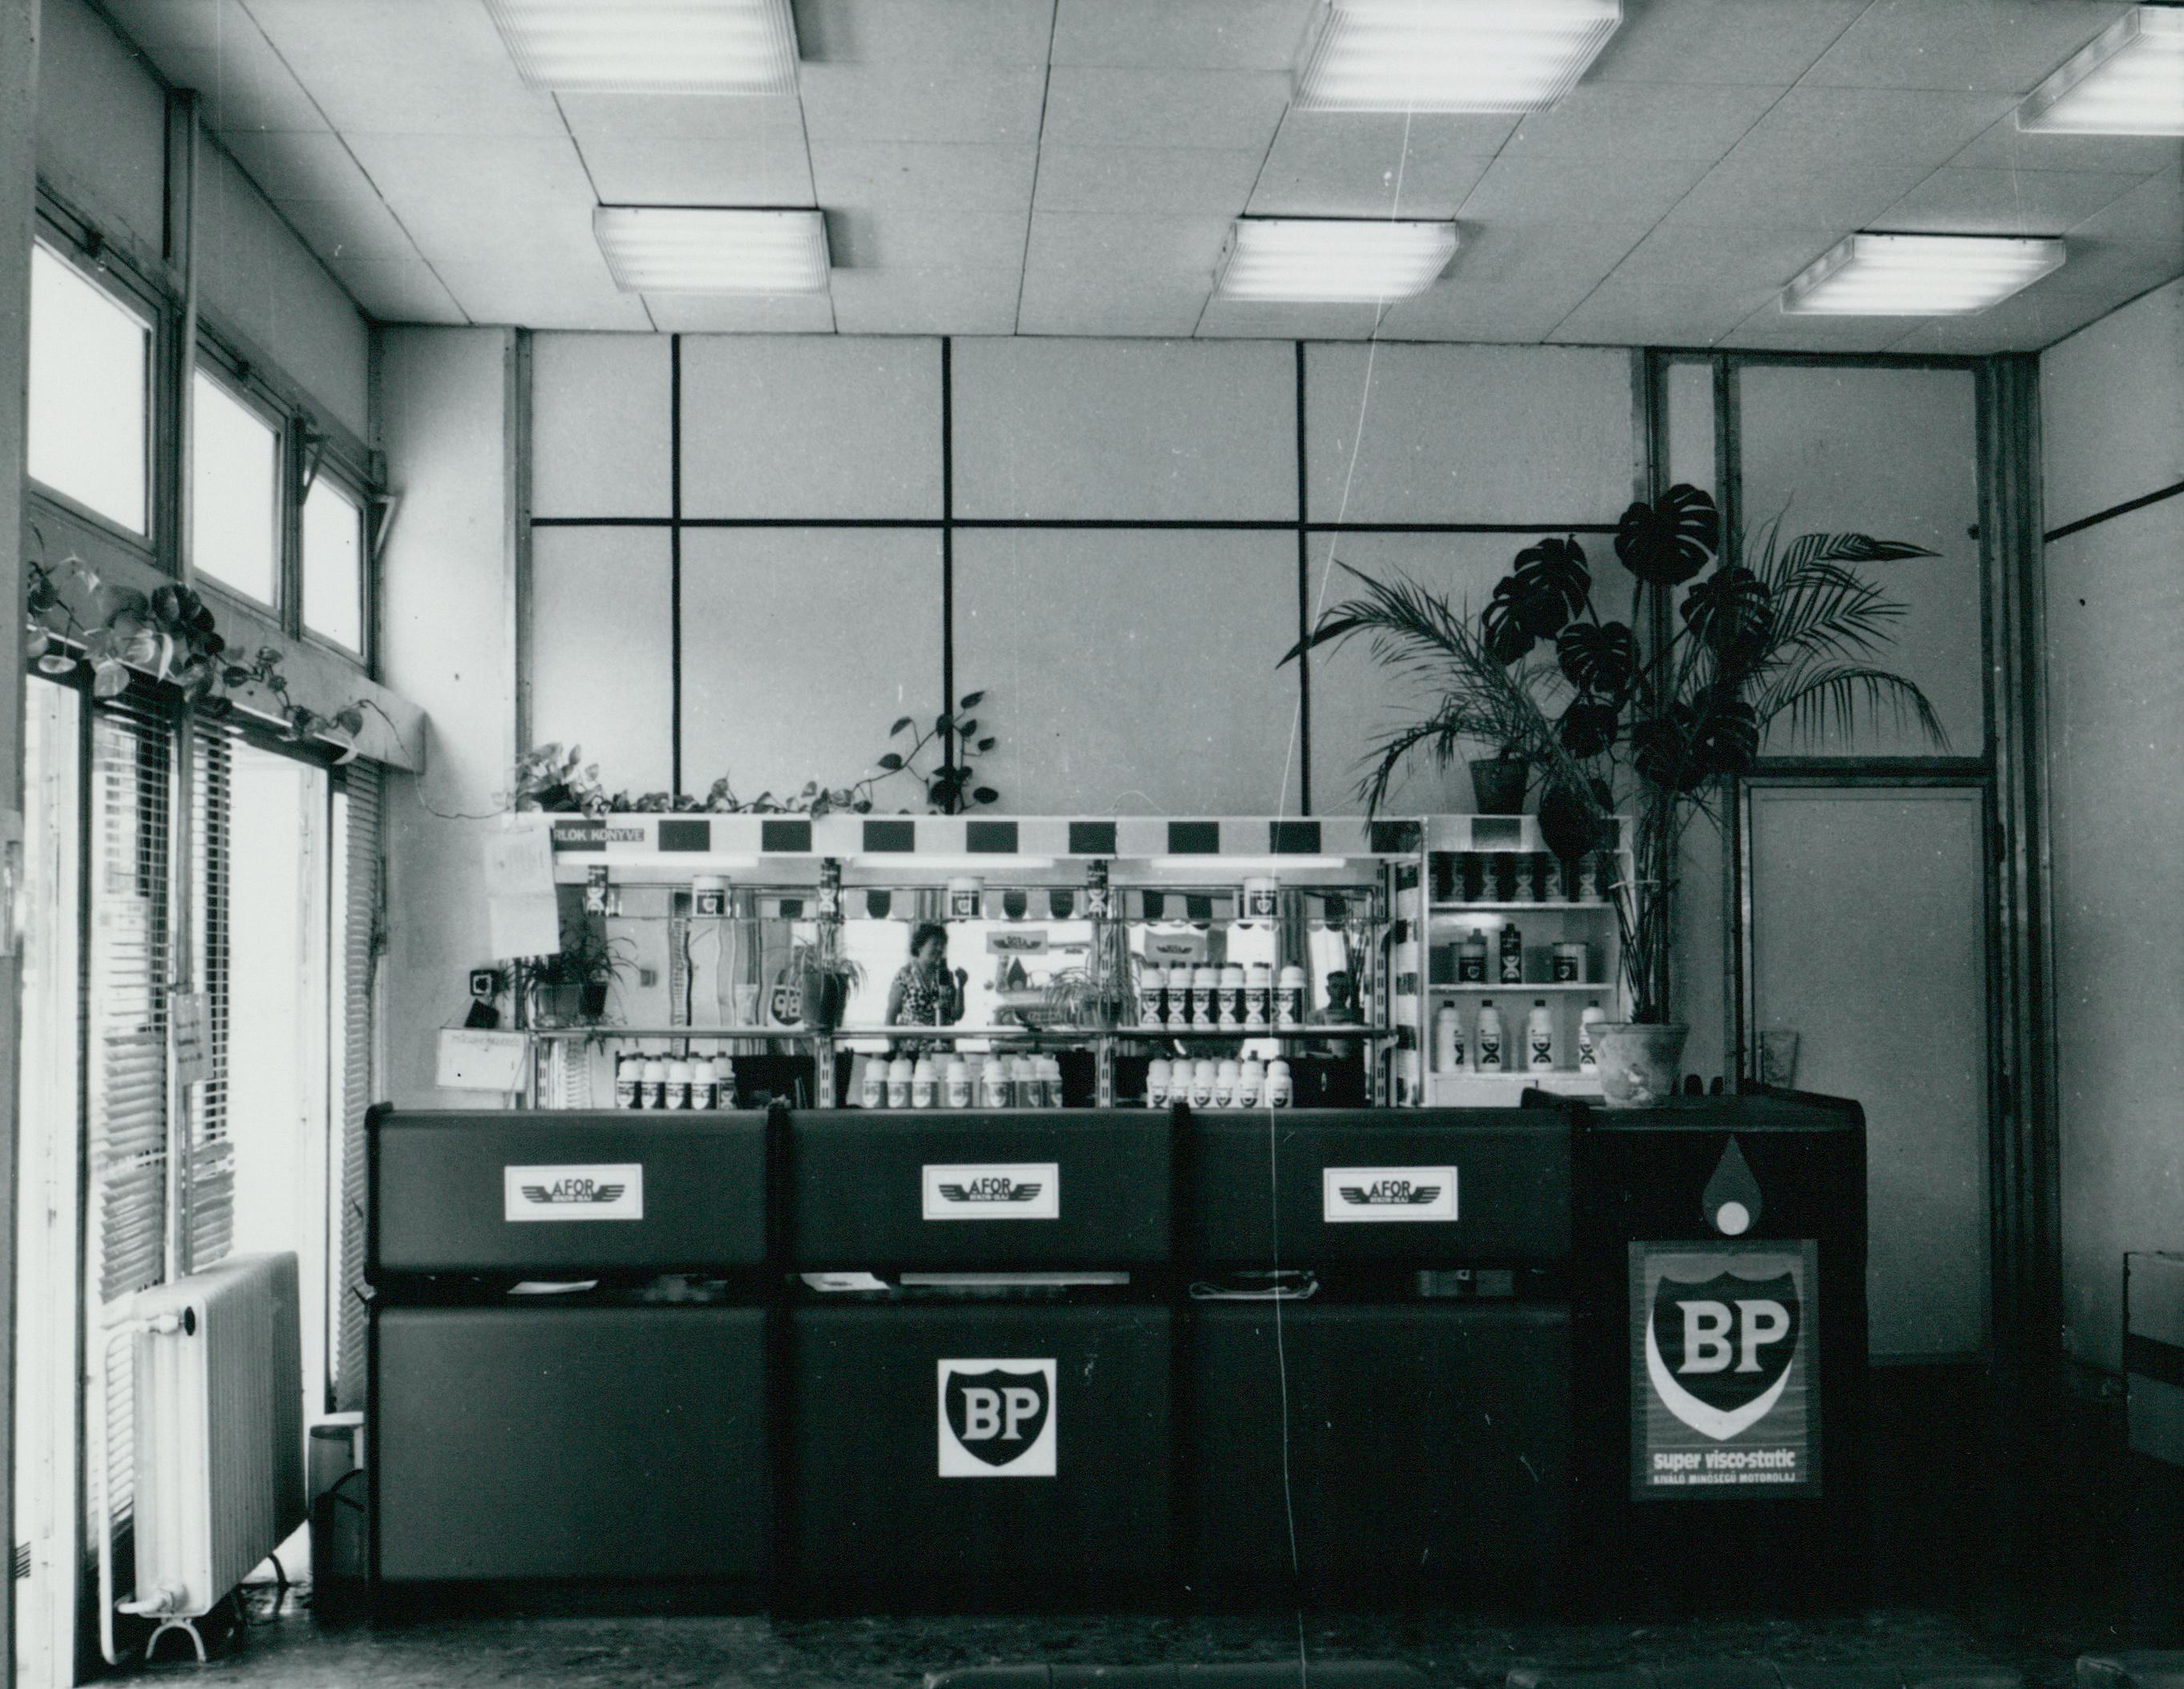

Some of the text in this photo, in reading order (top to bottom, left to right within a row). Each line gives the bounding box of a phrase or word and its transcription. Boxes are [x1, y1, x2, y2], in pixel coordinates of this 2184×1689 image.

[1675, 1299, 1790, 1373] BP
[961, 1387, 1041, 1440] BP
[1653, 1453, 1701, 1473] super
[1739, 1473, 1796, 1483] MOTOROLAJ
